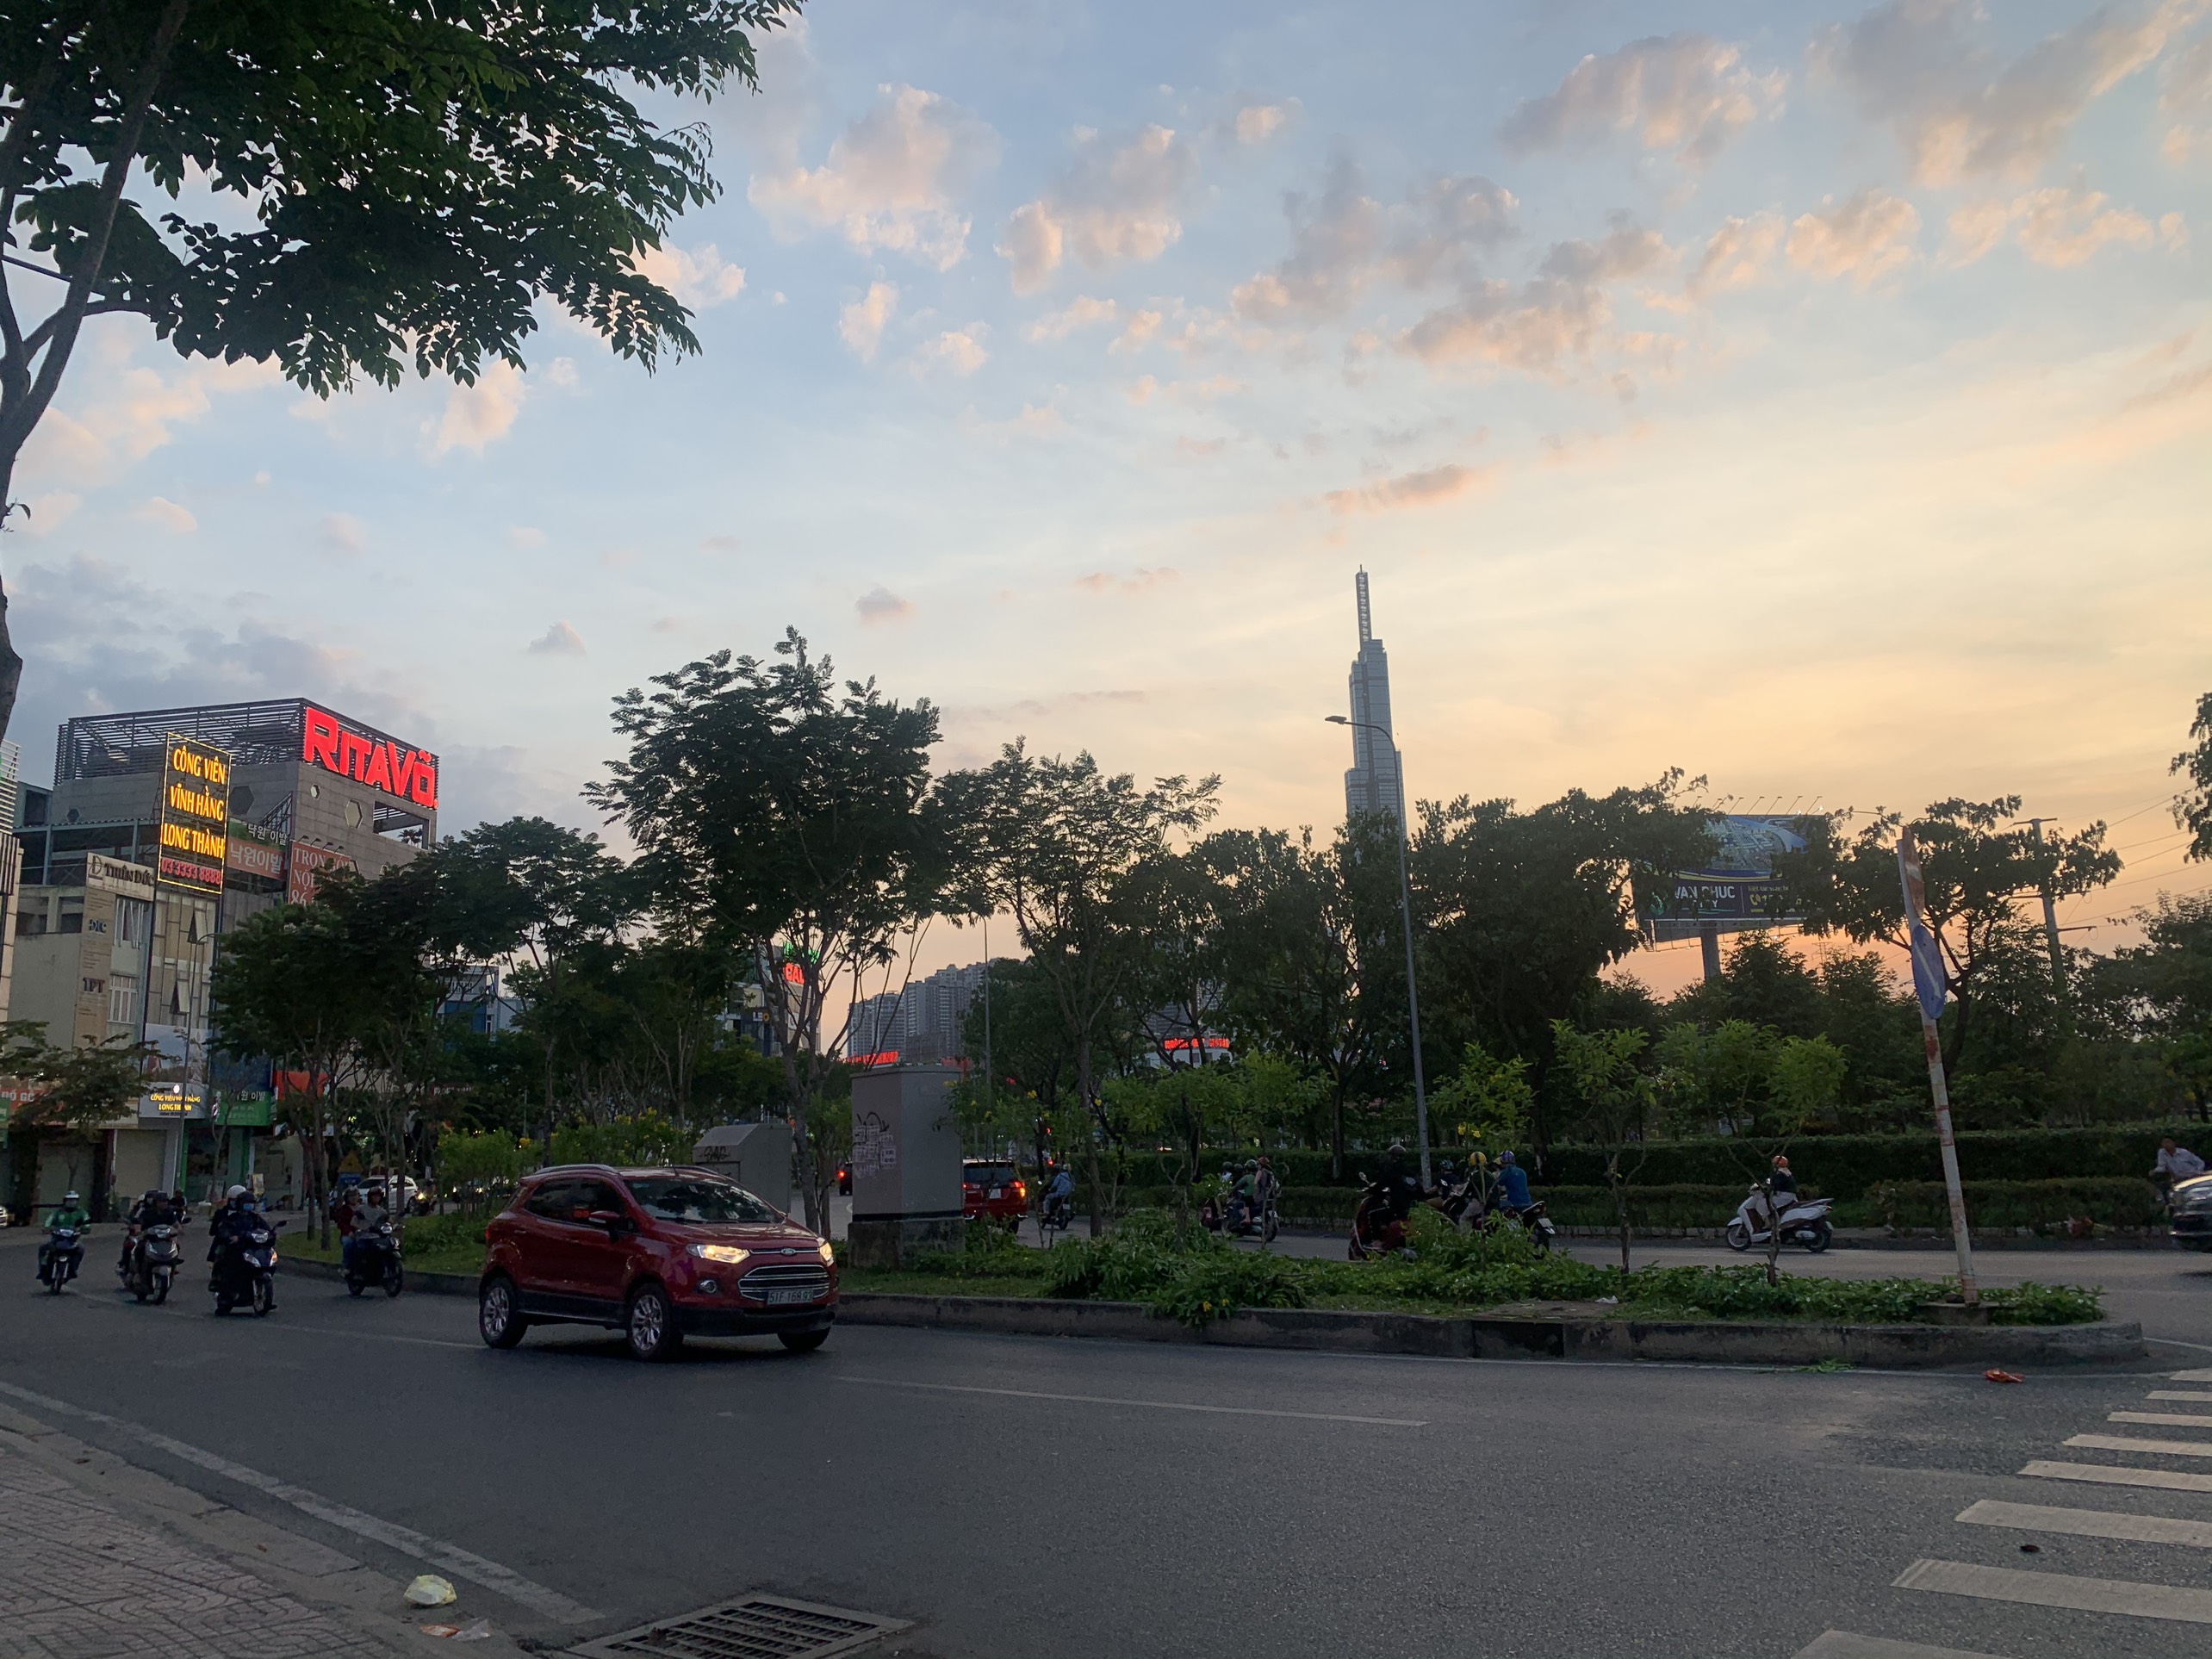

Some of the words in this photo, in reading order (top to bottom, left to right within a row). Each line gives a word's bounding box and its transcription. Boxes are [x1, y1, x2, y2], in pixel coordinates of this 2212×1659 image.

[173, 745, 202, 777] CÔNG
[204, 755, 226, 785] VIÊN
[170, 782, 195, 813] VĨNH
[196, 785, 224, 821] HẰNG
[163, 823, 190, 850] LONG
[191, 828, 225, 859] THÀNH
[199, 865, 221, 885] 8888
